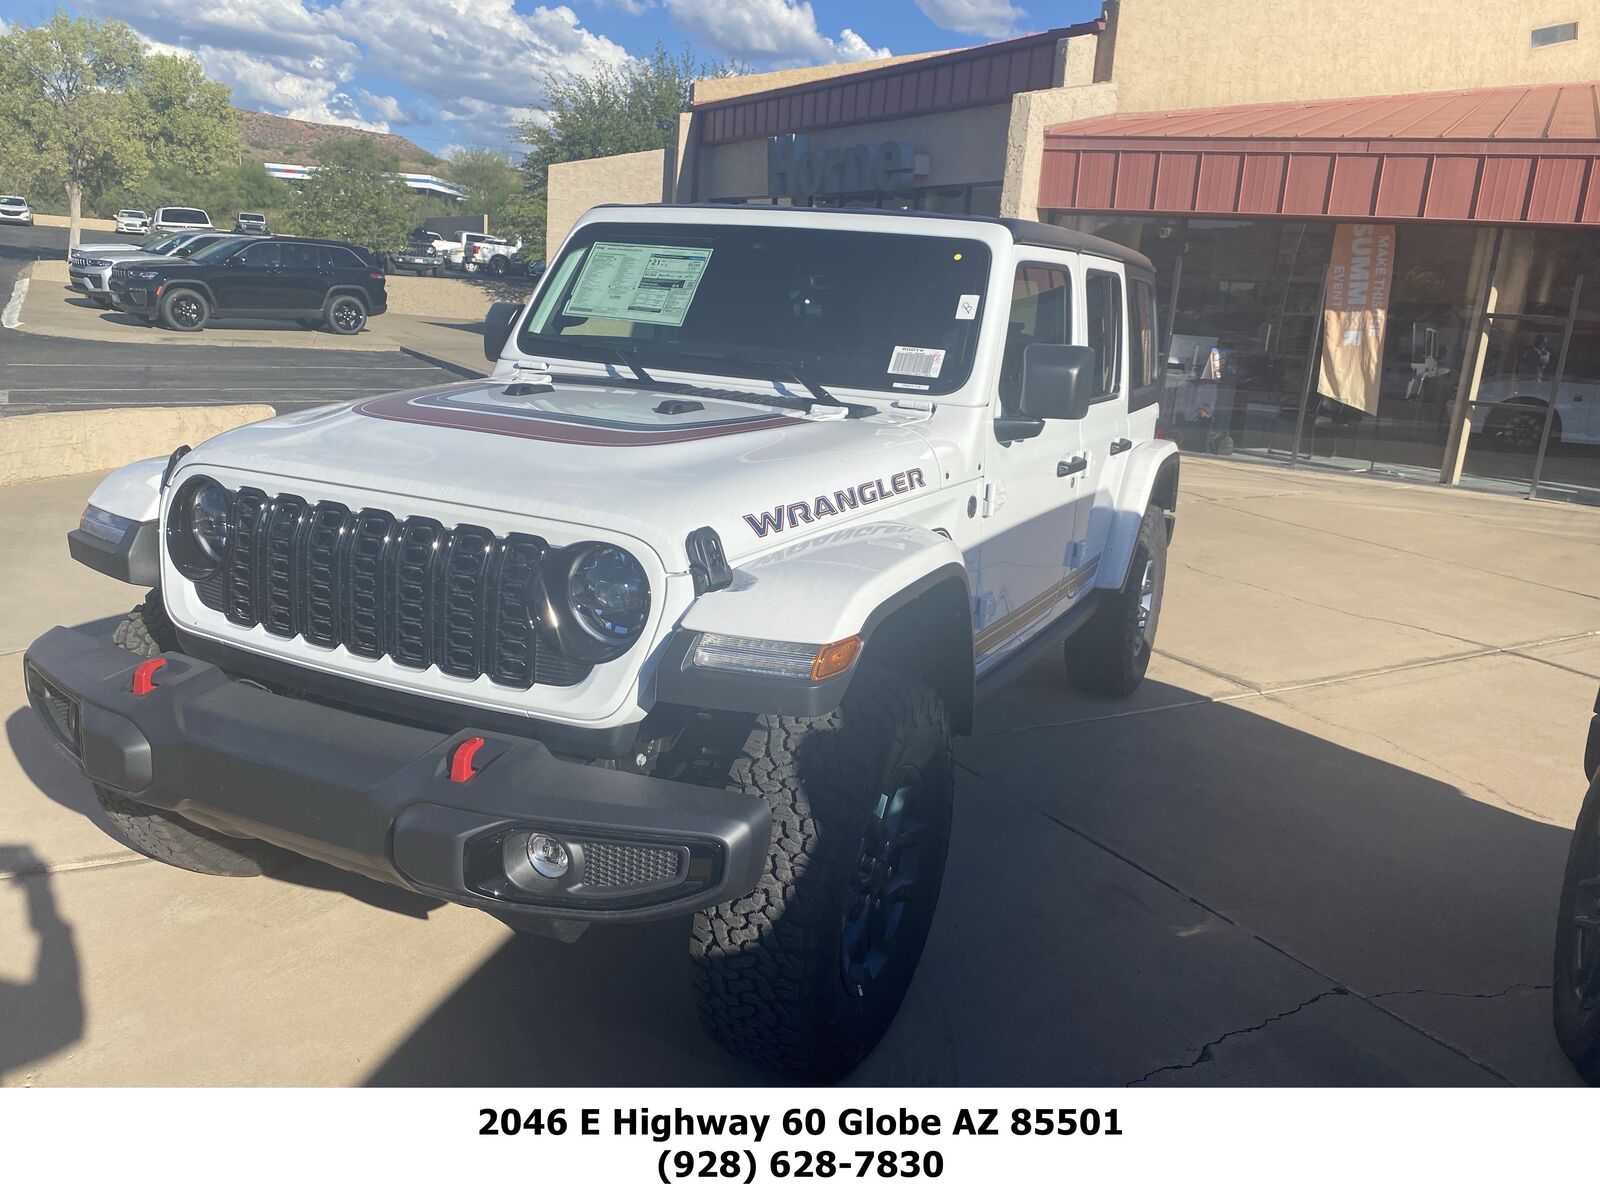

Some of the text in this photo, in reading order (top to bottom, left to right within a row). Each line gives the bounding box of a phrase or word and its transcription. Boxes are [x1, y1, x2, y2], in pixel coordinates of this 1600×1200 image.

[1375, 236, 1389, 275] MAKE
[1332, 266, 1344, 307] EVENT
[1371, 278, 1385, 308] THIS
[743, 468, 926, 538] WRANGLER
